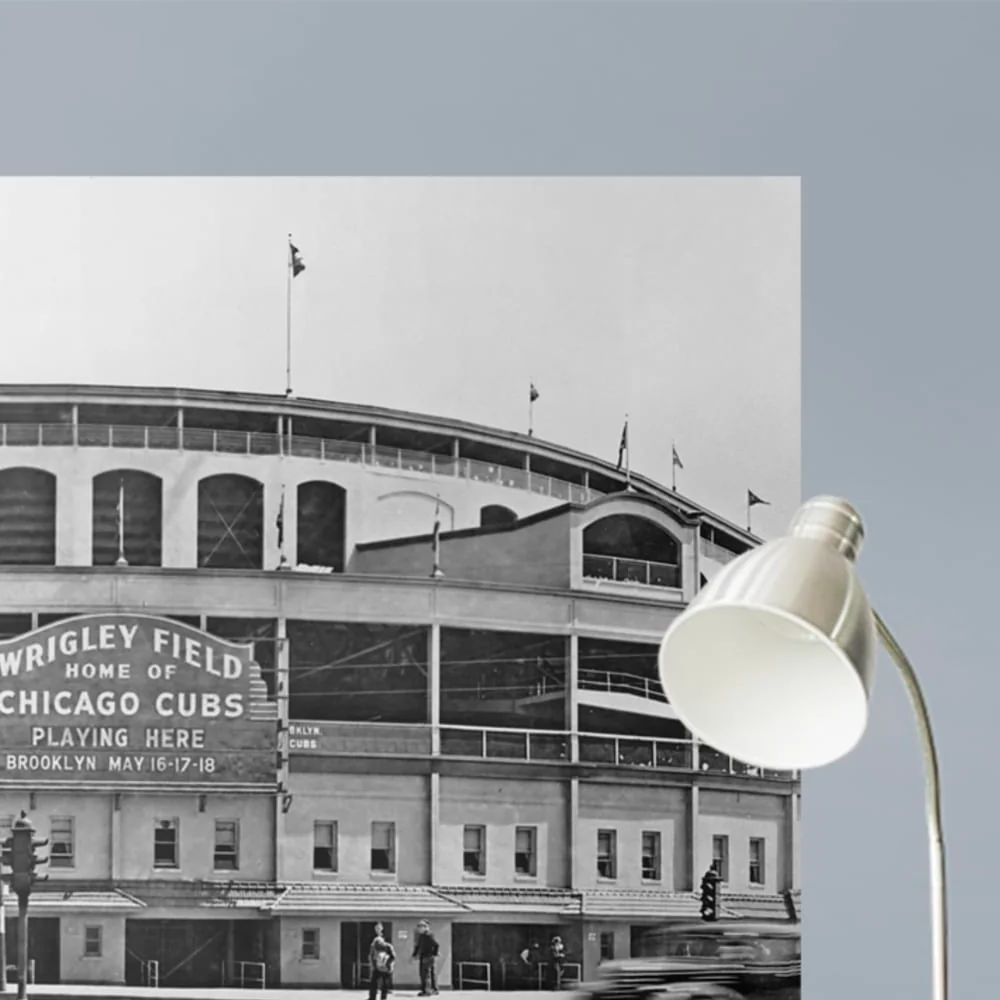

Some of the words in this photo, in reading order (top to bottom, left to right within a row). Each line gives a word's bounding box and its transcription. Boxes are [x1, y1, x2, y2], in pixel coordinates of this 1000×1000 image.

[153, 628, 243, 680] FIELD
[65, 663, 131, 679] HOME
[147, 664, 177, 680] OF
[156, 692, 244, 717] CUBS
[32, 727, 128, 747] PLAYING
[145, 728, 205, 748] HERE
[289, 739, 317, 749] CUBS
[6, 755, 96, 771] BROOKLYN
[108, 756, 144, 772] MAY
[151, 757, 216, 773] 16-17-18
